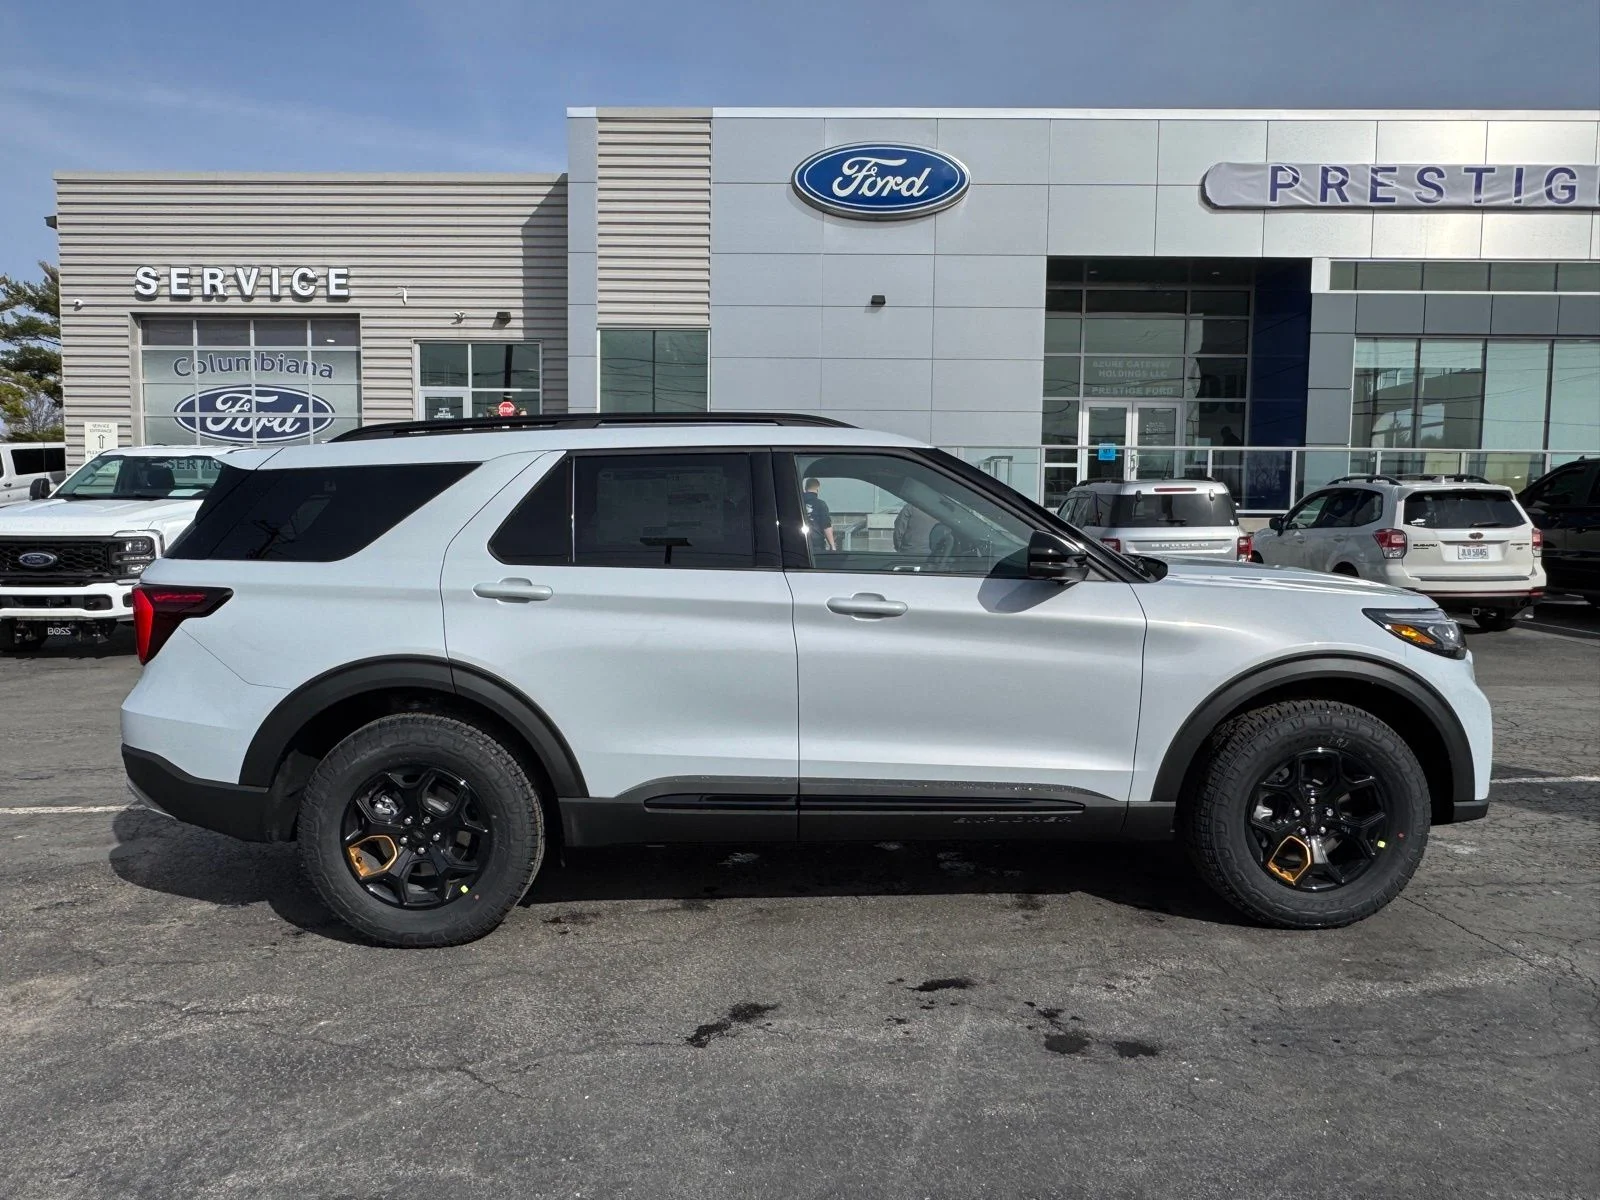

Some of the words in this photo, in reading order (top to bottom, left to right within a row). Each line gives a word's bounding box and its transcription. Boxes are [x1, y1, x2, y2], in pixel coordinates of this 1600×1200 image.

[832, 156, 932, 197] Ford
[1268, 165, 1600, 205] PRESTIG
[135, 265, 349, 297] SERVICE
[173, 352, 333, 379] Columbiana
[1098, 369, 1148, 378] HOLDINGS
[1150, 369, 1168, 378] LLC
[1091, 386, 1143, 395] PRESTIGE
[1145, 386, 1174, 395] FORD
[206, 393, 303, 432] Ford
[167, 458, 222, 470] SERVIC
[47, 627, 71, 635] BOSS
